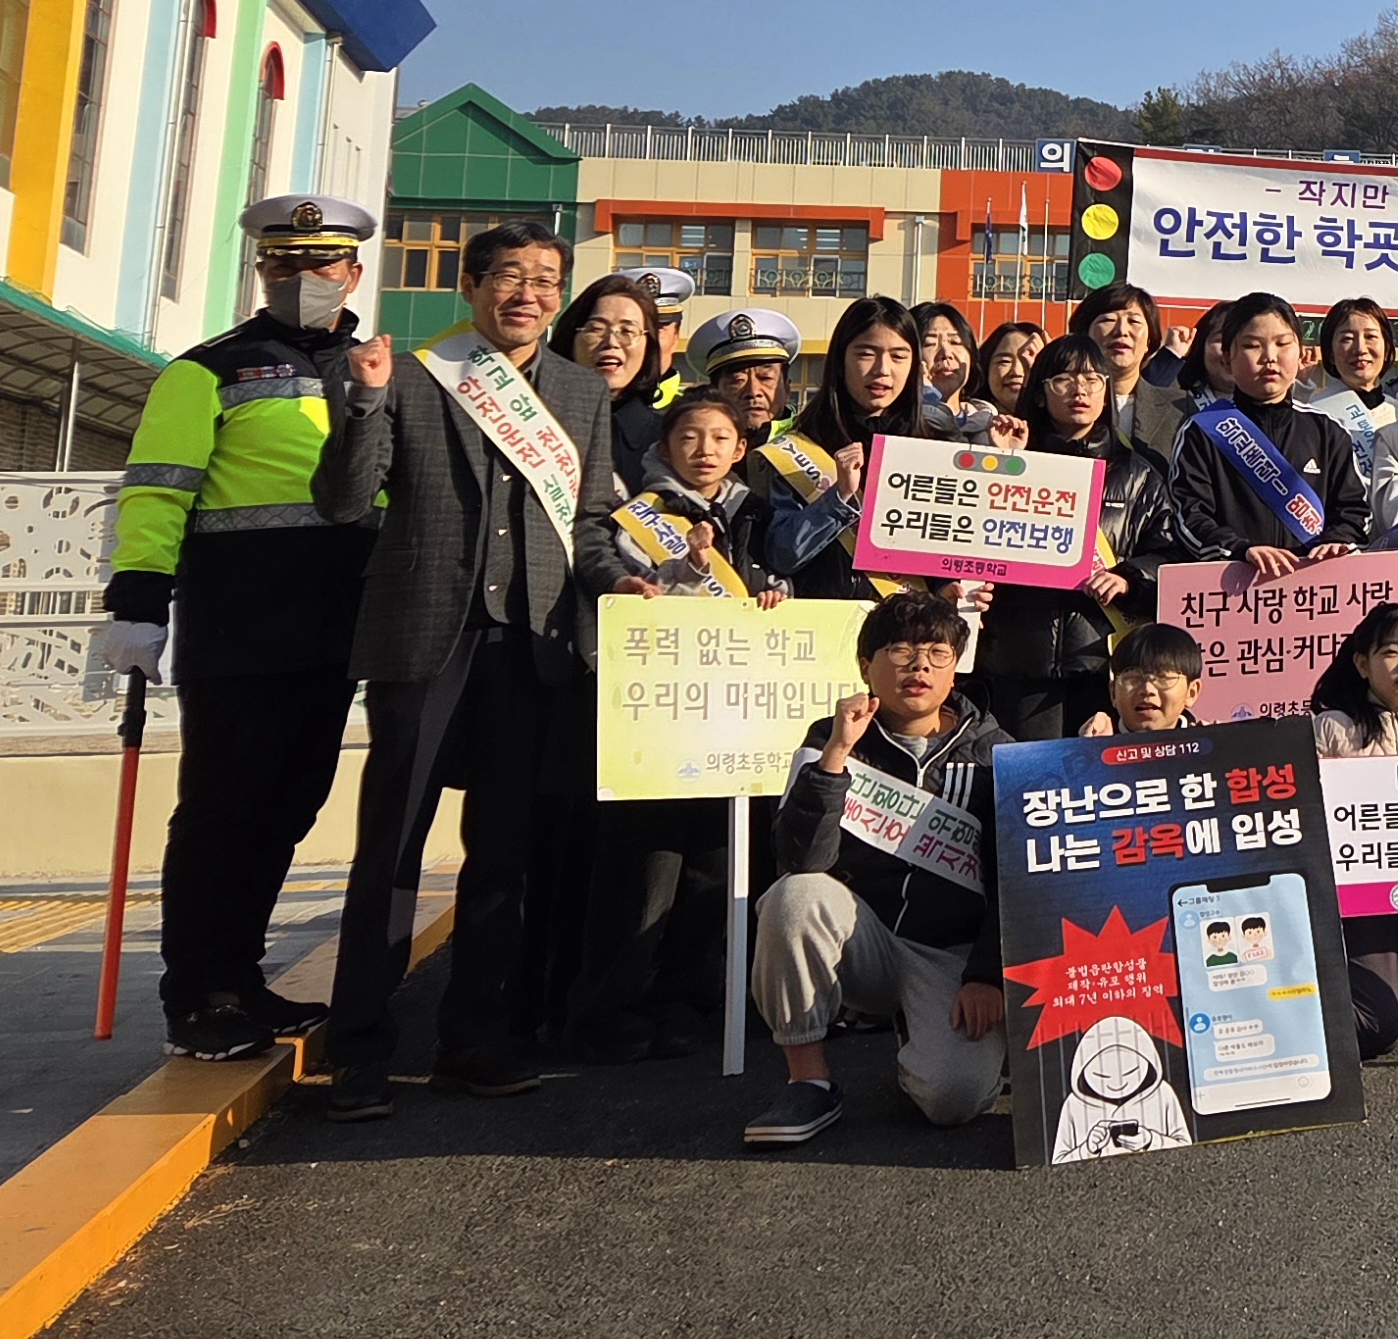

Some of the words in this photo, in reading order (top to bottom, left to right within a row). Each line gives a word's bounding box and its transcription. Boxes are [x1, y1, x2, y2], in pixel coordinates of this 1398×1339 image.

[1299, 180, 1388, 210] 작지만
[1154, 206, 1301, 263] 안전한
[467, 344, 515, 391] 학교
[509, 393, 538, 423] 앞
[457, 375, 547, 469] 안전운전
[782, 442, 821, 485] YES
[1217, 417, 1288, 495] 학교폭력!
[887, 472, 980, 508] 어른들은
[987, 482, 1078, 519] 안전운전
[628, 500, 688, 555] 친구사랑
[880, 508, 975, 544] 우리들은
[982, 518, 1074, 555] 안전보행
[941, 557, 1008, 577] 의령초등학교
[1181, 592, 1230, 628] 친구
[1237, 587, 1287, 624] 사랑
[1294, 584, 1340, 620] 학교
[623, 627, 680, 666] 폭력
[696, 628, 751, 667] 없는
[764, 629, 816, 667] 학교
[1200, 640, 1230, 677] 은
[1237, 637, 1284, 675] 관심
[1293, 633, 1353, 669] 커다
[622, 681, 710, 721] 우리의
[1116, 748, 1138, 762] 신고
[1140, 747, 1153, 759] 및
[1154, 744, 1177, 759] 상담
[1179, 742, 1200, 755] 112
[1023, 778, 1171, 827] 장난으로
[1179, 773, 1217, 810] 한
[1225, 763, 1298, 805] 합성
[1027, 834, 1101, 873] 나는
[1112, 818, 1222, 866] 감옥에
[1231, 809, 1302, 851] 입성
[1052, 993, 1076, 1008] 최대
[1078, 991, 1099, 1006] 7년
[1102, 987, 1138, 1004] 이하의
[1141, 983, 1165, 999] 징역
[1124, 972, 1148, 987] 행위
